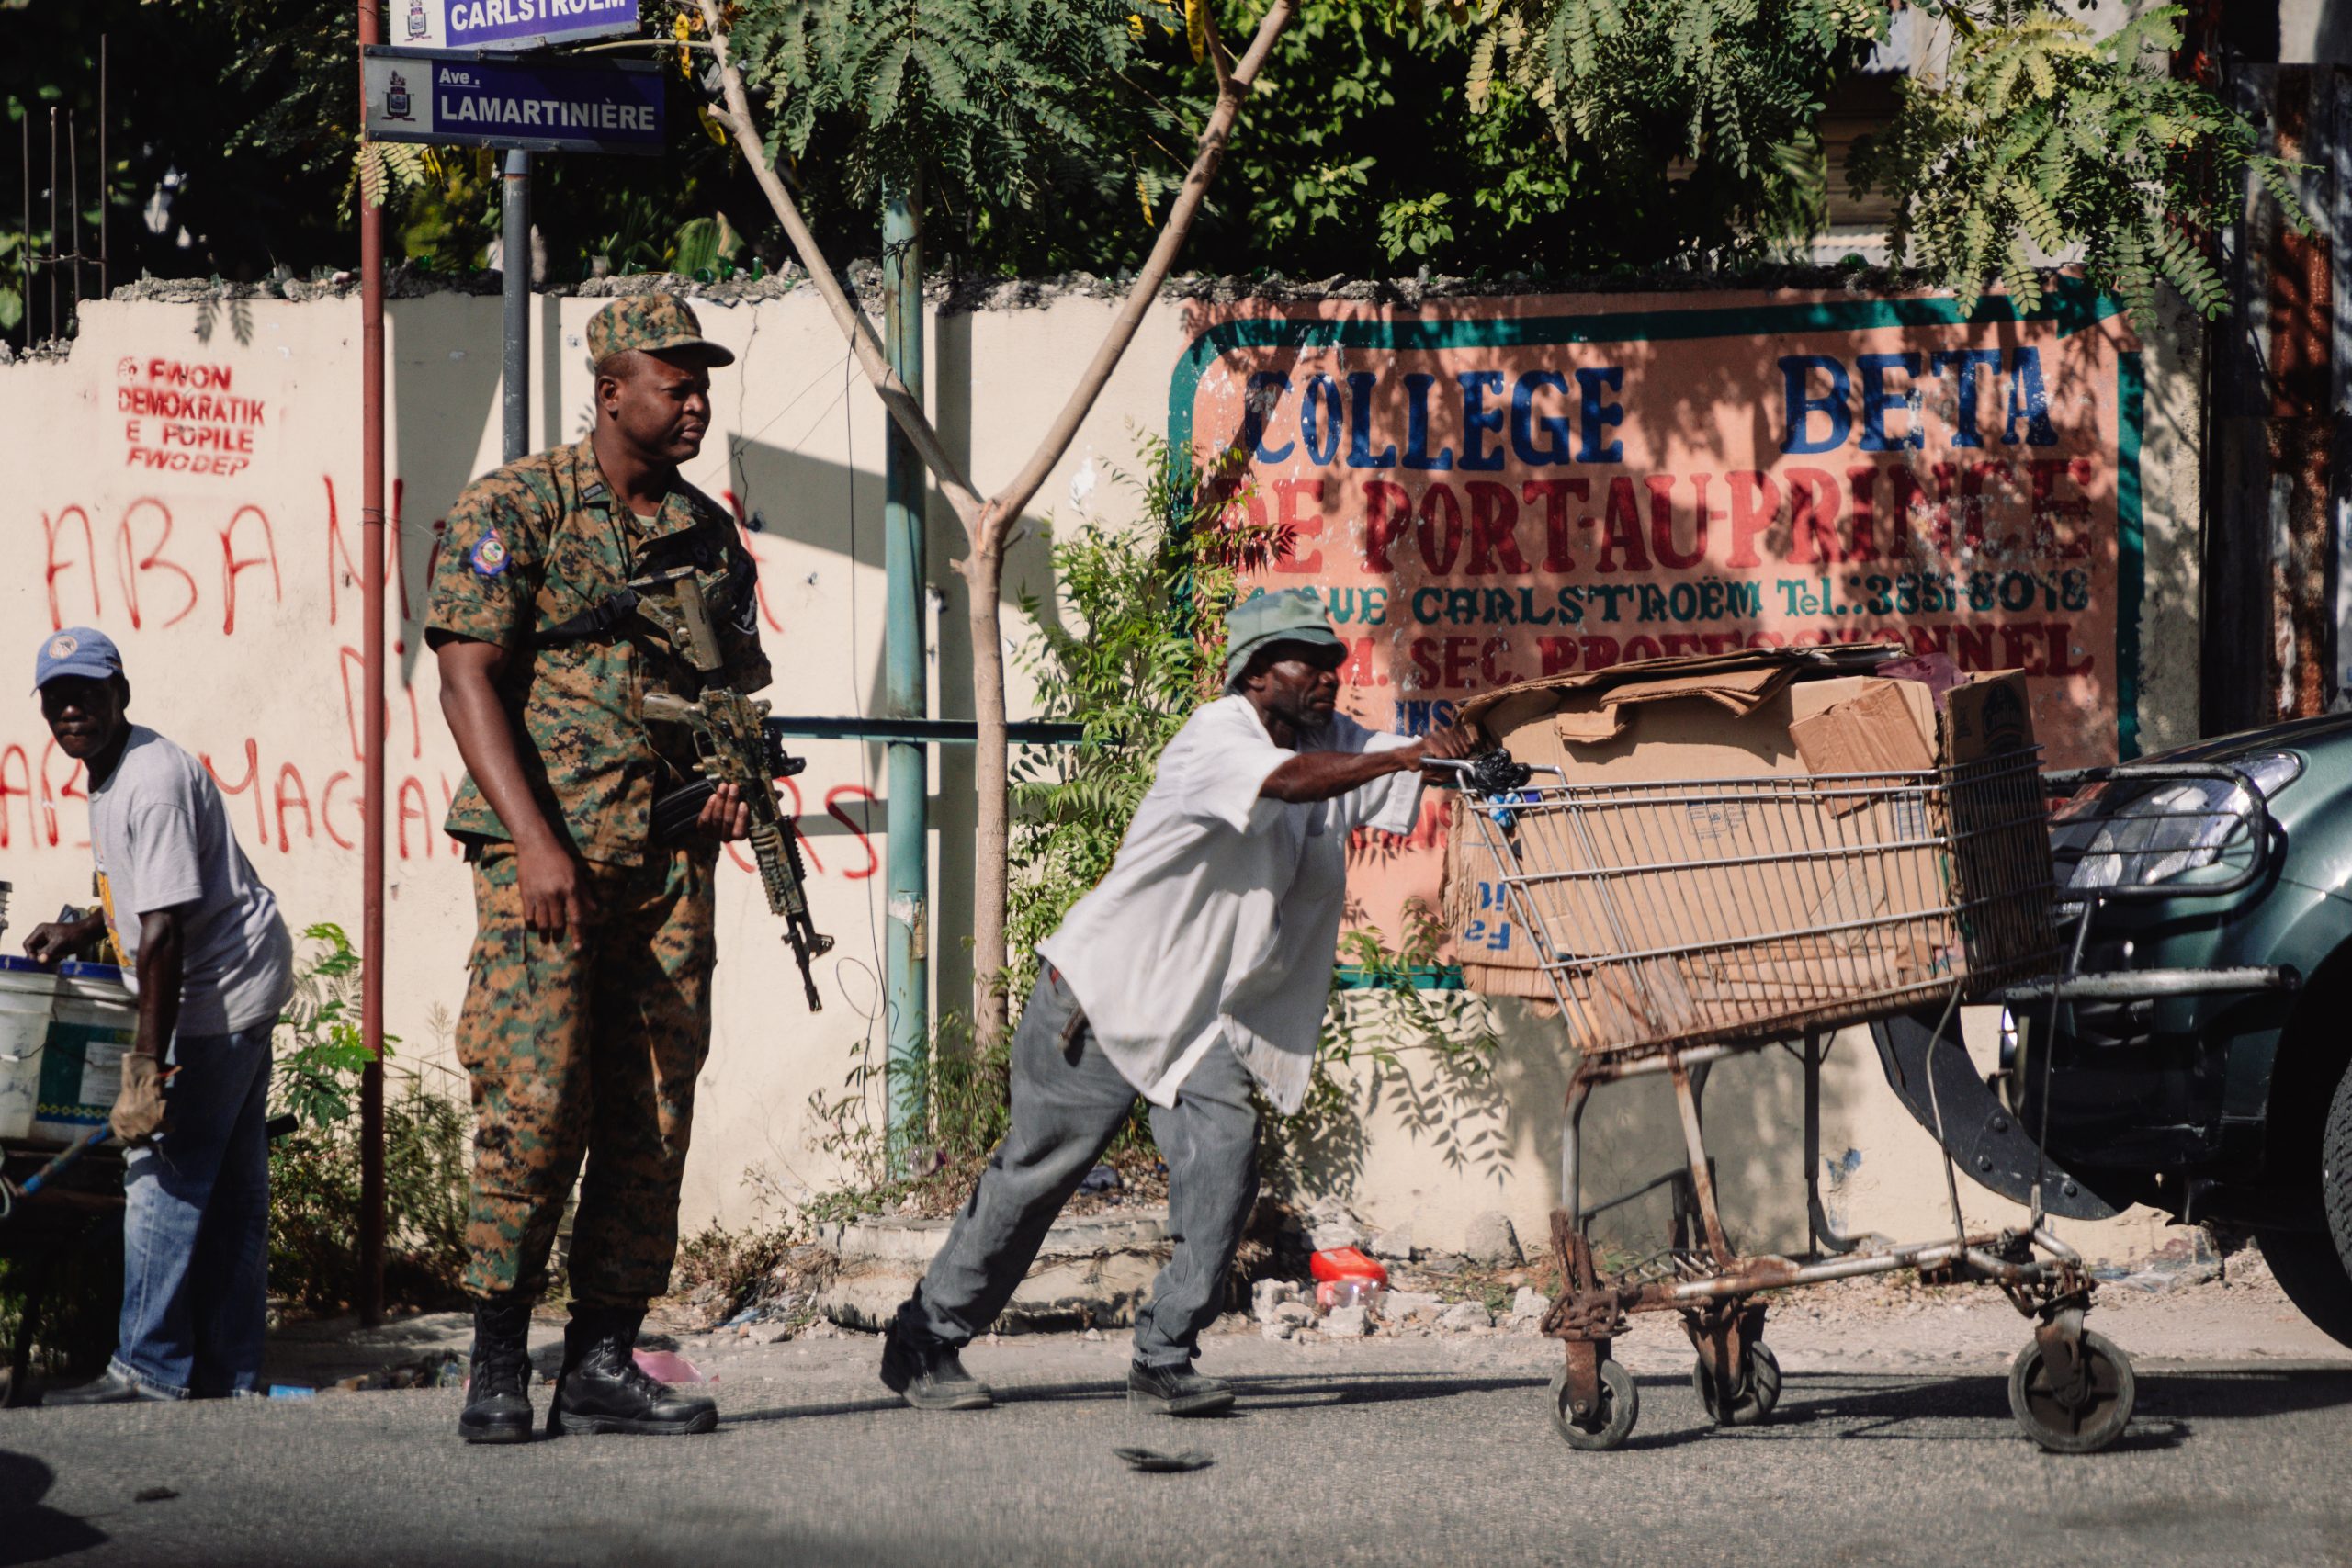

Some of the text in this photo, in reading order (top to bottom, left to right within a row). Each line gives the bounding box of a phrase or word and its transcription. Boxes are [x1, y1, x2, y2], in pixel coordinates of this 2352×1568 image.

[450, 0, 627, 31] CARLSTR
[441, 95, 655, 130] LAMARTINIÈRE
[118, 386, 266, 426] DEMOKRATIK
[1244, 346, 2059, 471] COLLEGE BETA
[163, 423, 254, 454] POPILE
[126, 446, 250, 477] FWODEP
[1360, 458, 2093, 577] PORT-AU-PRINCE
[1412, 575, 1763, 626] CARLSTROËM
[1411, 636, 1525, 690] SEC.
